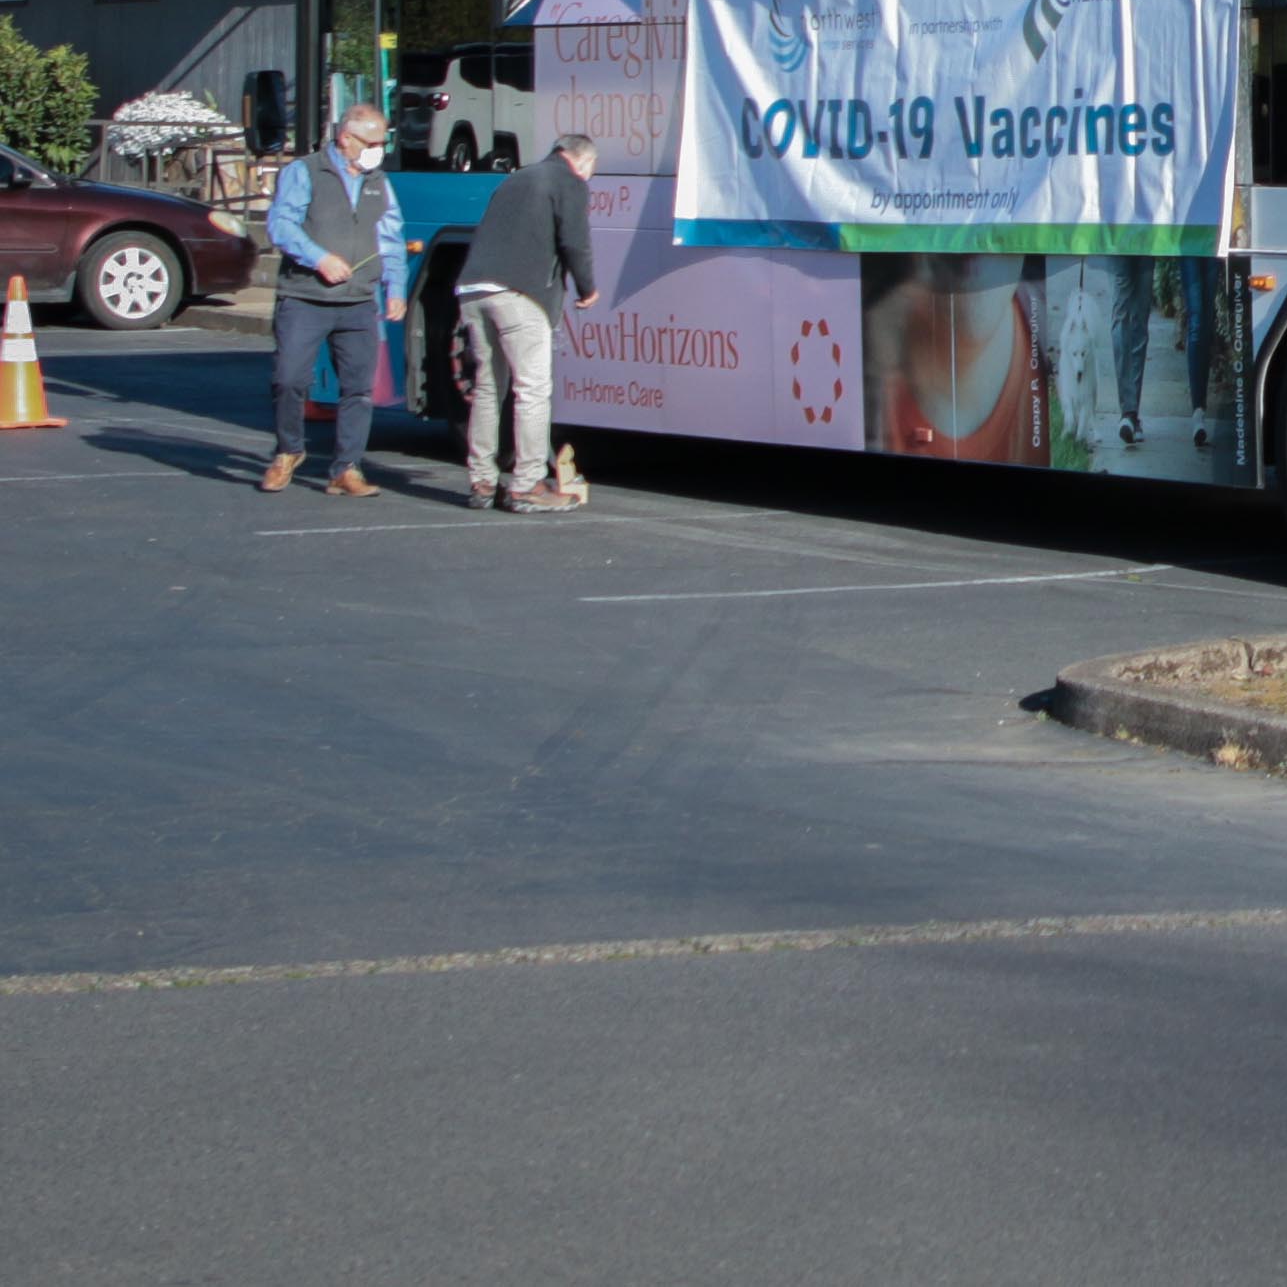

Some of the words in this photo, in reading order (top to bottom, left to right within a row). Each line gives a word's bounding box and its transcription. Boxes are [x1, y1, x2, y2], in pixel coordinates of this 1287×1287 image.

[909, 20, 919, 35] in
[554, 75, 664, 156] change
[741, 96, 935, 160] COVID-19
[954, 88, 1175, 157] Vaccines
[619, 185, 631, 212] P.
[870, 187, 891, 214] by
[893, 186, 990, 214] appointment
[991, 185, 1020, 213] only
[561, 308, 740, 370] NewHorizons
[1030, 296, 1039, 370] Caregiver
[1233, 273, 1243, 353] Caregiver
[563, 375, 625, 405] In-Home
[628, 380, 665, 409] Care
[1030, 395, 1041, 448] Cappy
[1234, 378, 1246, 466] Madeleine
